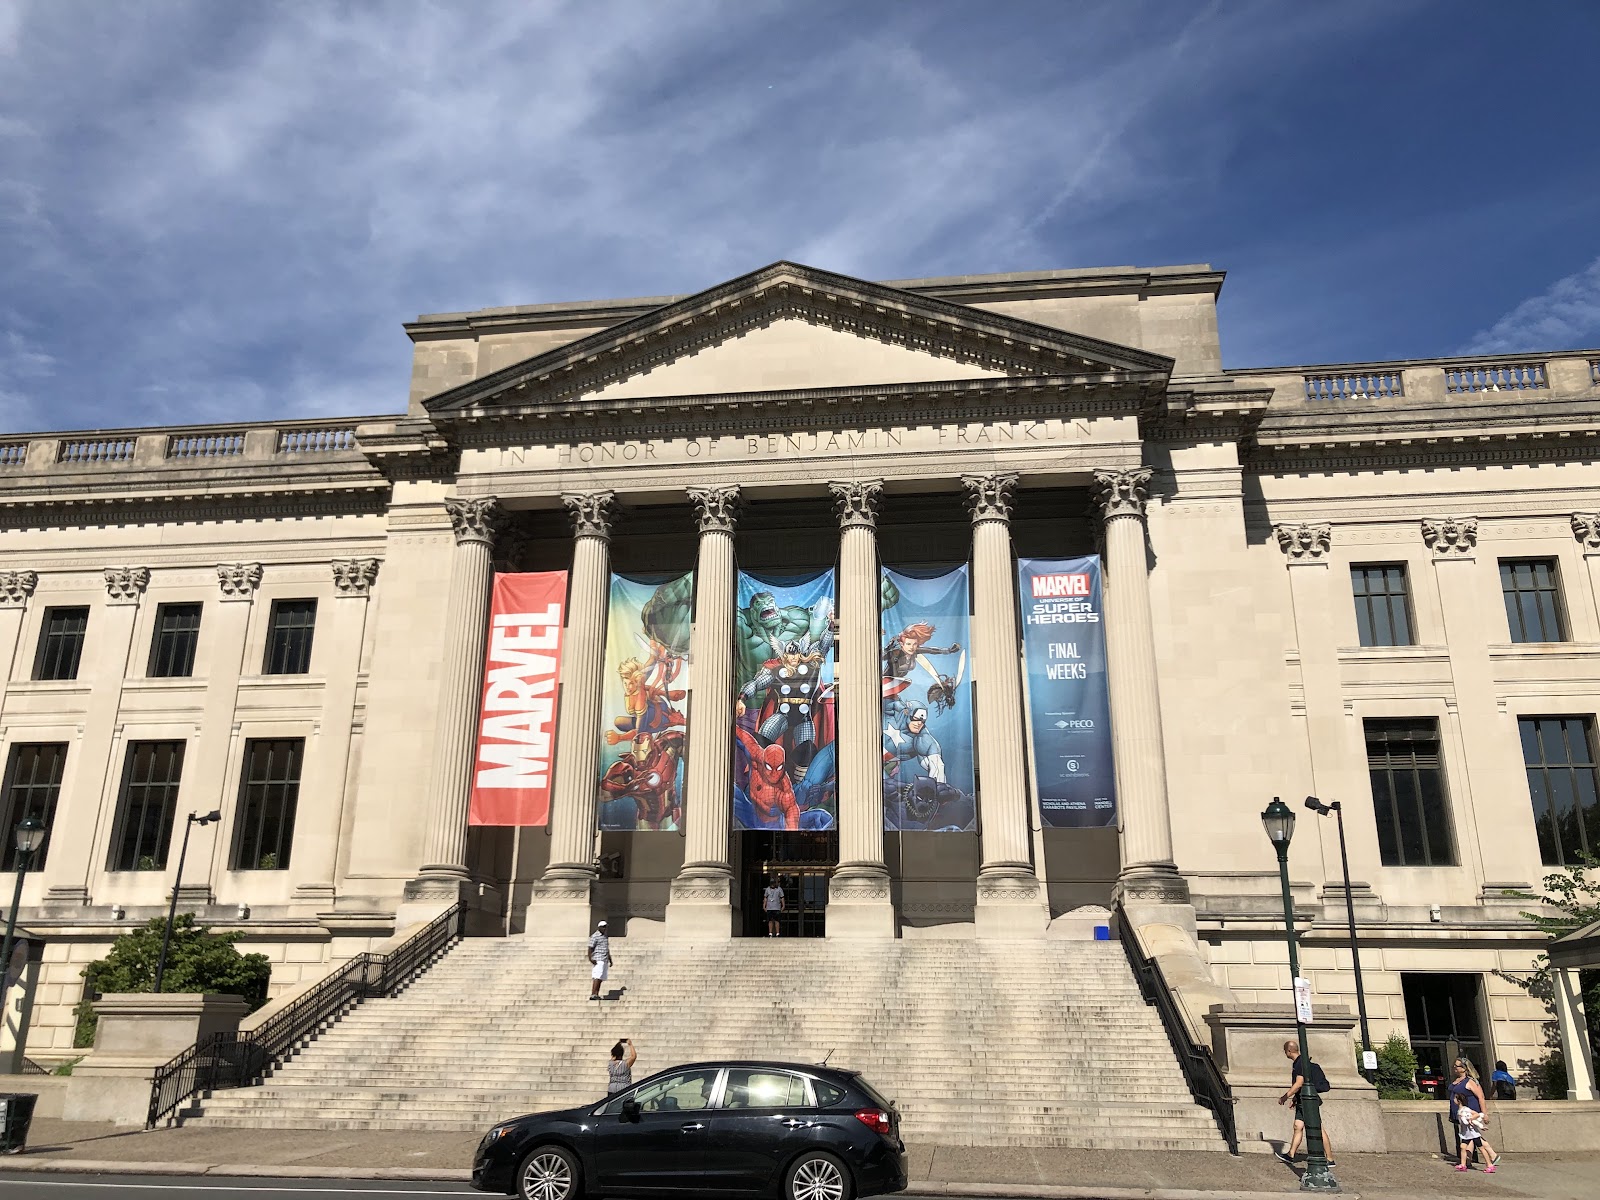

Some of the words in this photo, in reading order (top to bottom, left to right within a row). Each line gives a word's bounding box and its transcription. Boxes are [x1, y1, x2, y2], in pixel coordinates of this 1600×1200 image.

[500, 450, 525, 467] IN
[557, 443, 658, 463] HONOR
[686, 440, 717, 457] OF
[747, 430, 903, 454] BENJAMIN
[938, 422, 1093, 445] FRANKLIN
[1032, 575, 1090, 597] MARVEL
[1032, 603, 1092, 614] SUPER
[1027, 612, 1100, 625] HEROES
[1048, 643, 1081, 659] FINAL
[1046, 663, 1087, 680] WEEKS
[476, 603, 561, 789] MARVEL
[1069, 719, 1094, 728] PECO
